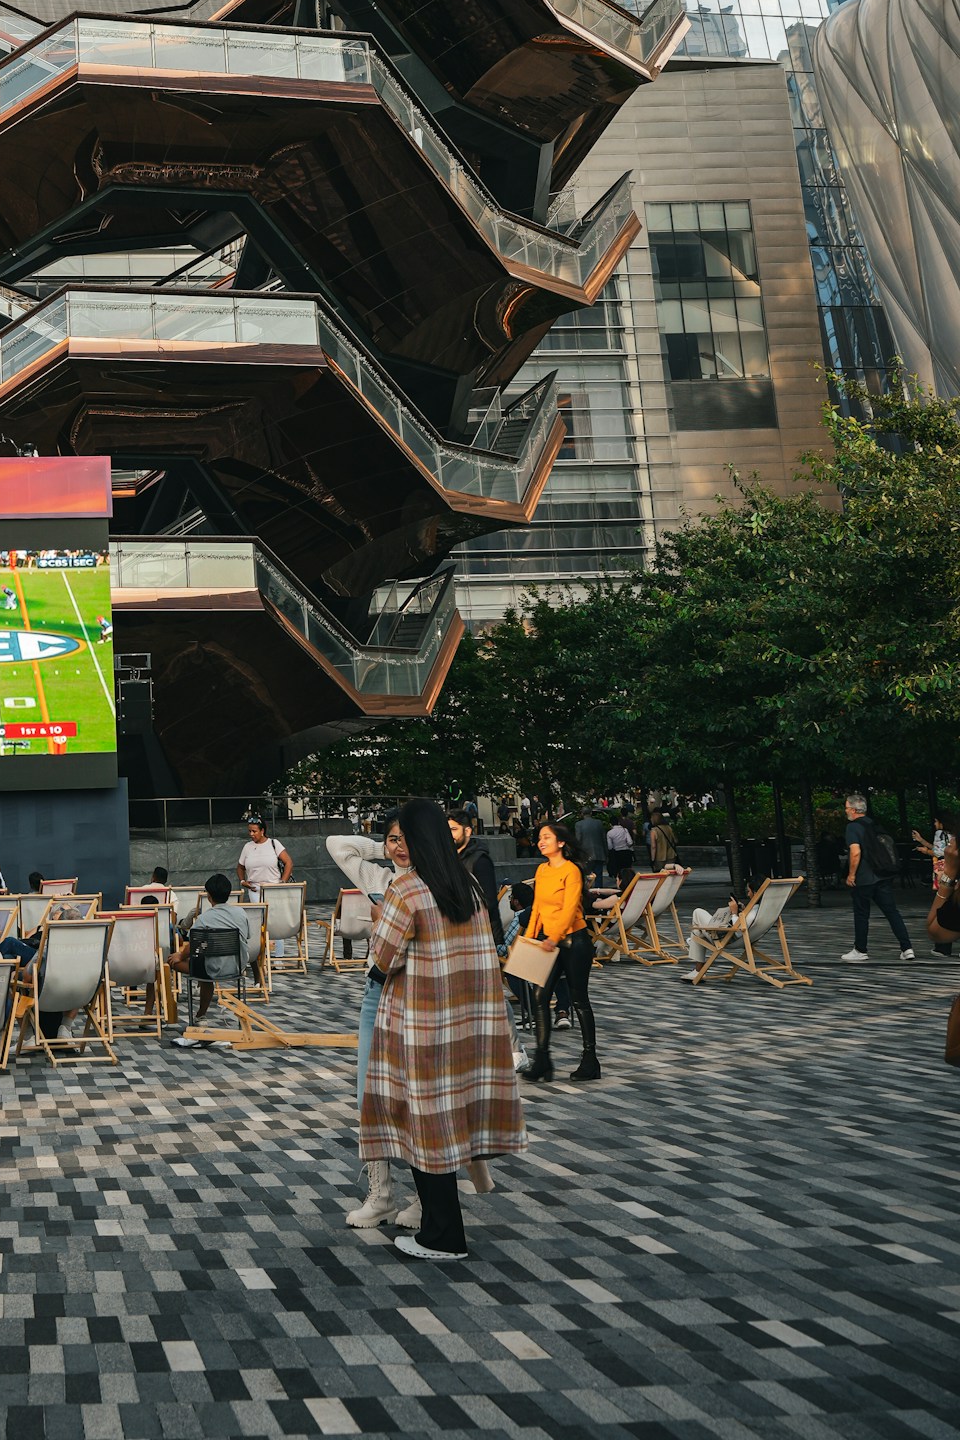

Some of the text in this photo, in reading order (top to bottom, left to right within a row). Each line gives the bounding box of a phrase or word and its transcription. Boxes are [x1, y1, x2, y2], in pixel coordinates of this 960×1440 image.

[47, 558, 94, 567] CBS SEC
[20, 727, 36, 736] 1ST
[49, 725, 63, 735] 10
